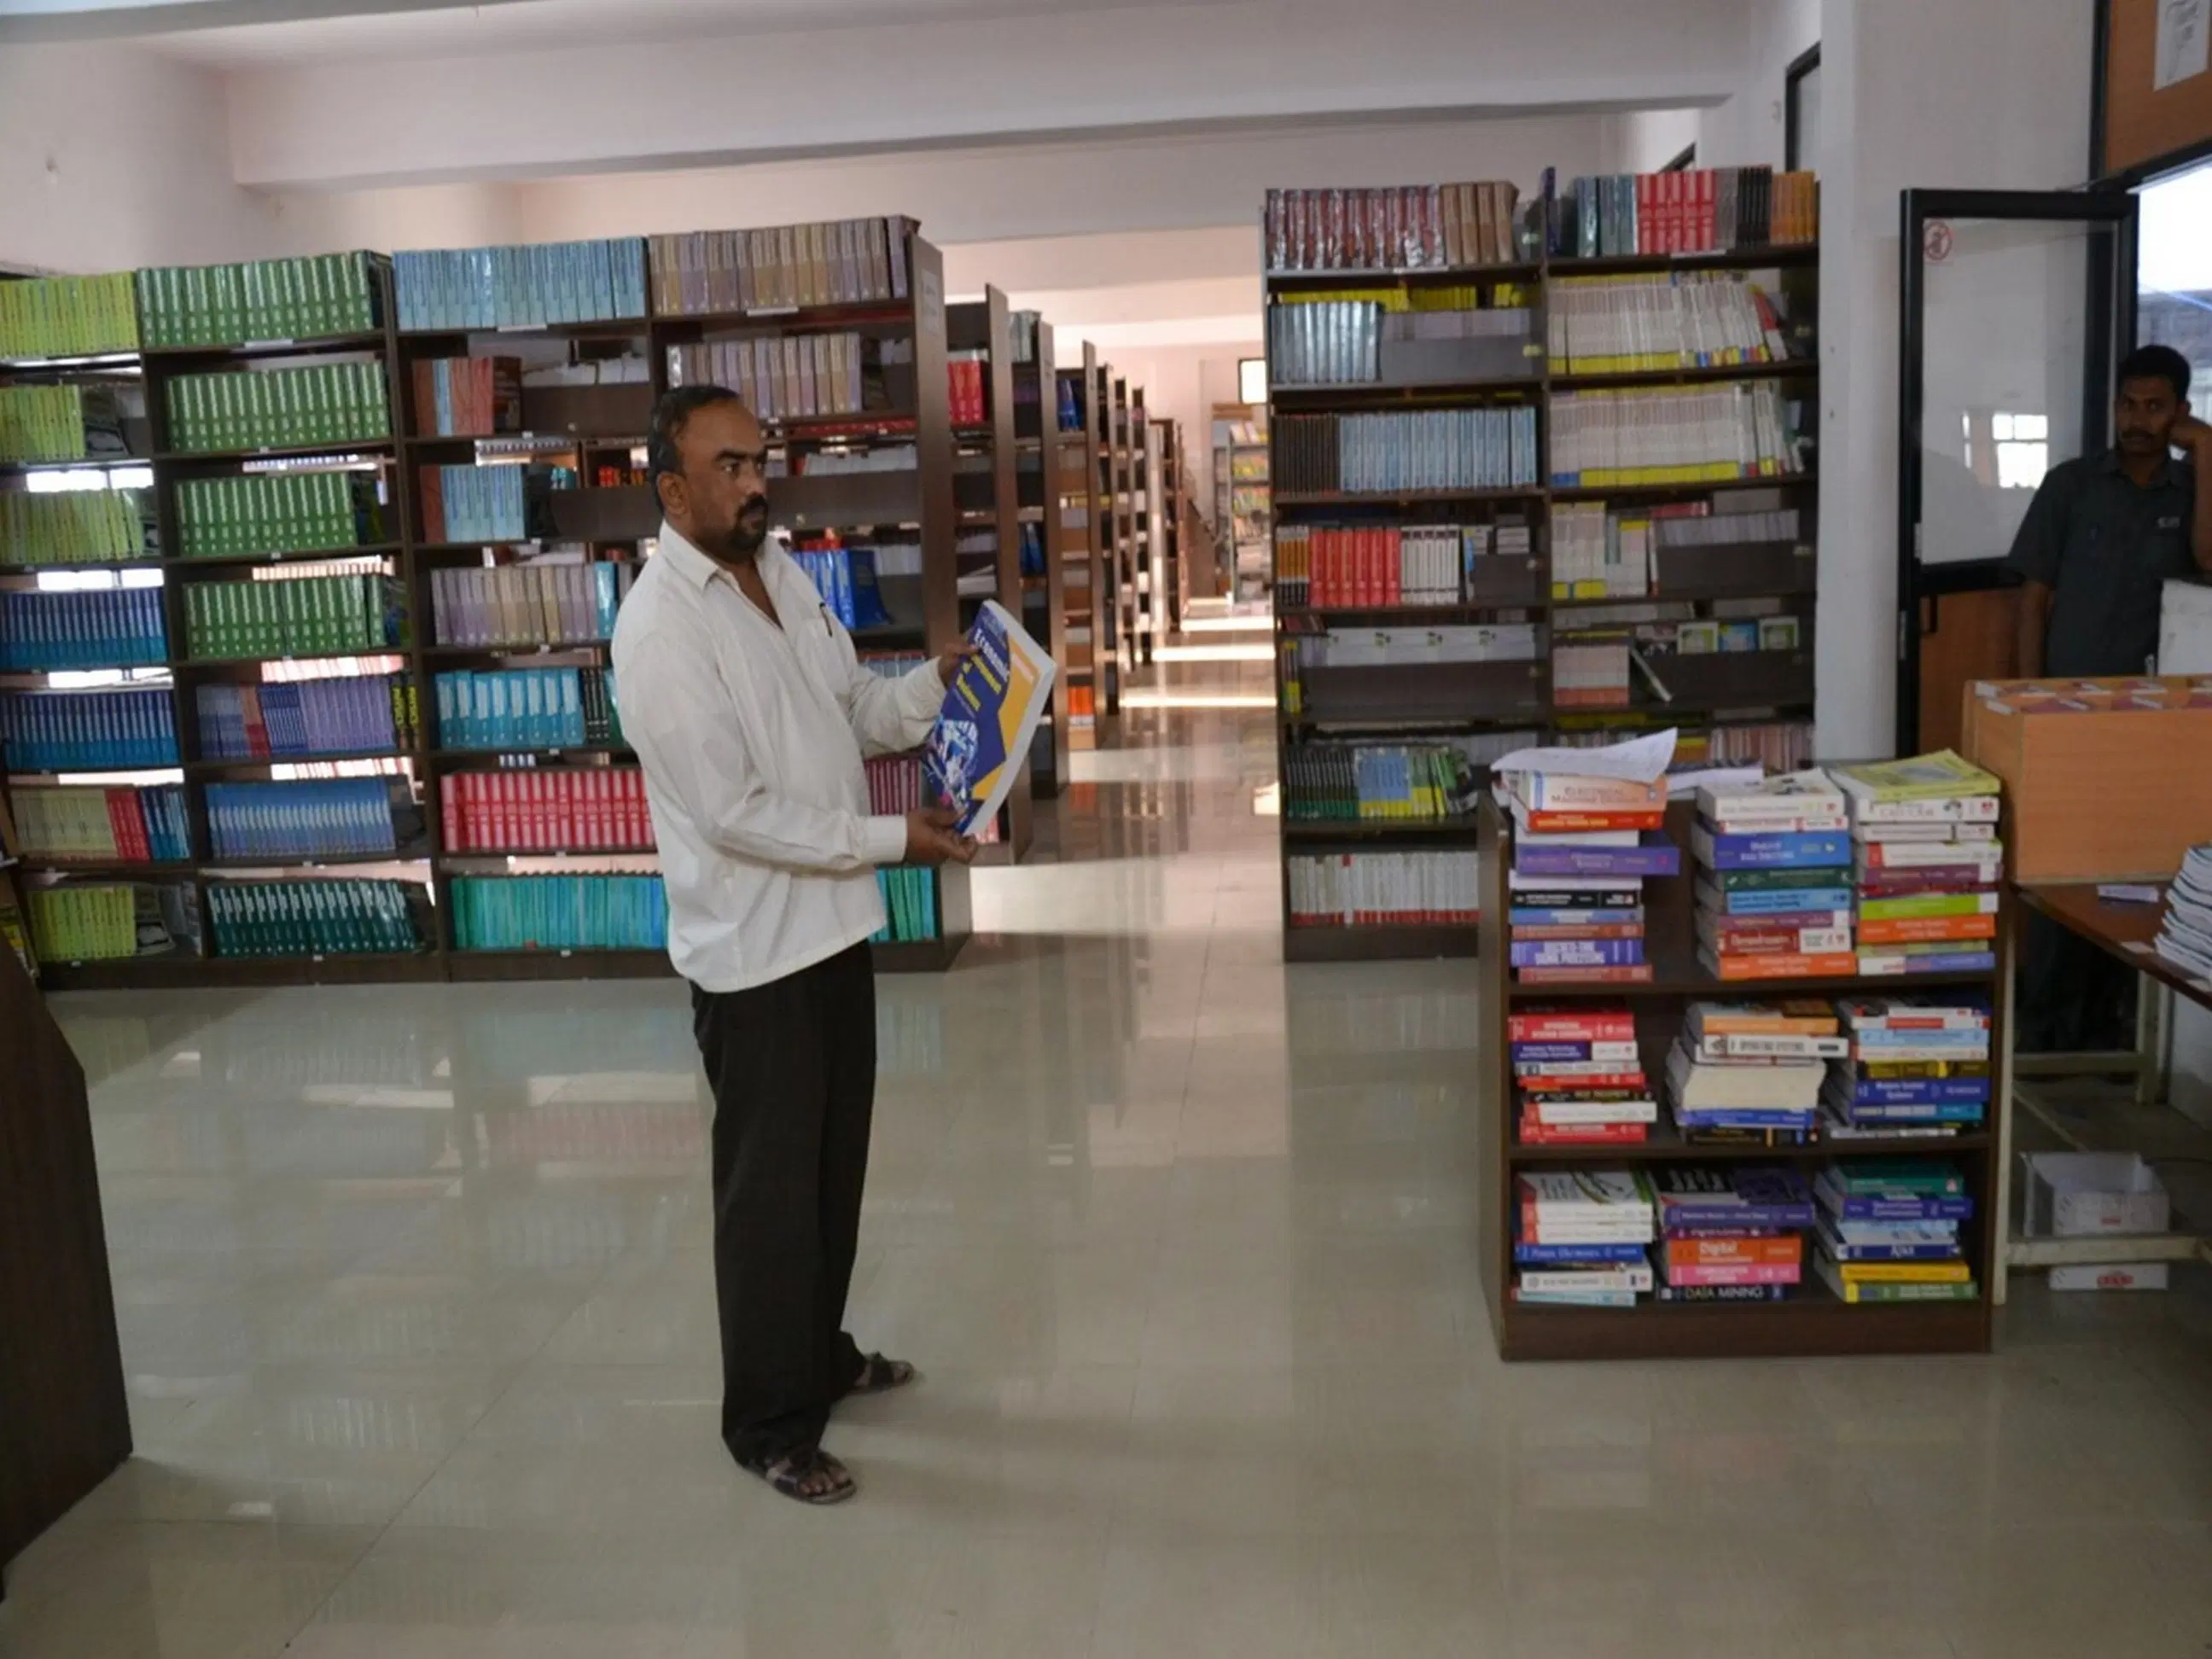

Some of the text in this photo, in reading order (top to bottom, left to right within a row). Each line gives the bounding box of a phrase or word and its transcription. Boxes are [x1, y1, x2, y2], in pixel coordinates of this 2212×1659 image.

[1699, 1241, 1738, 1256] Digital
[1685, 1287, 1764, 1299] DATA MINING
